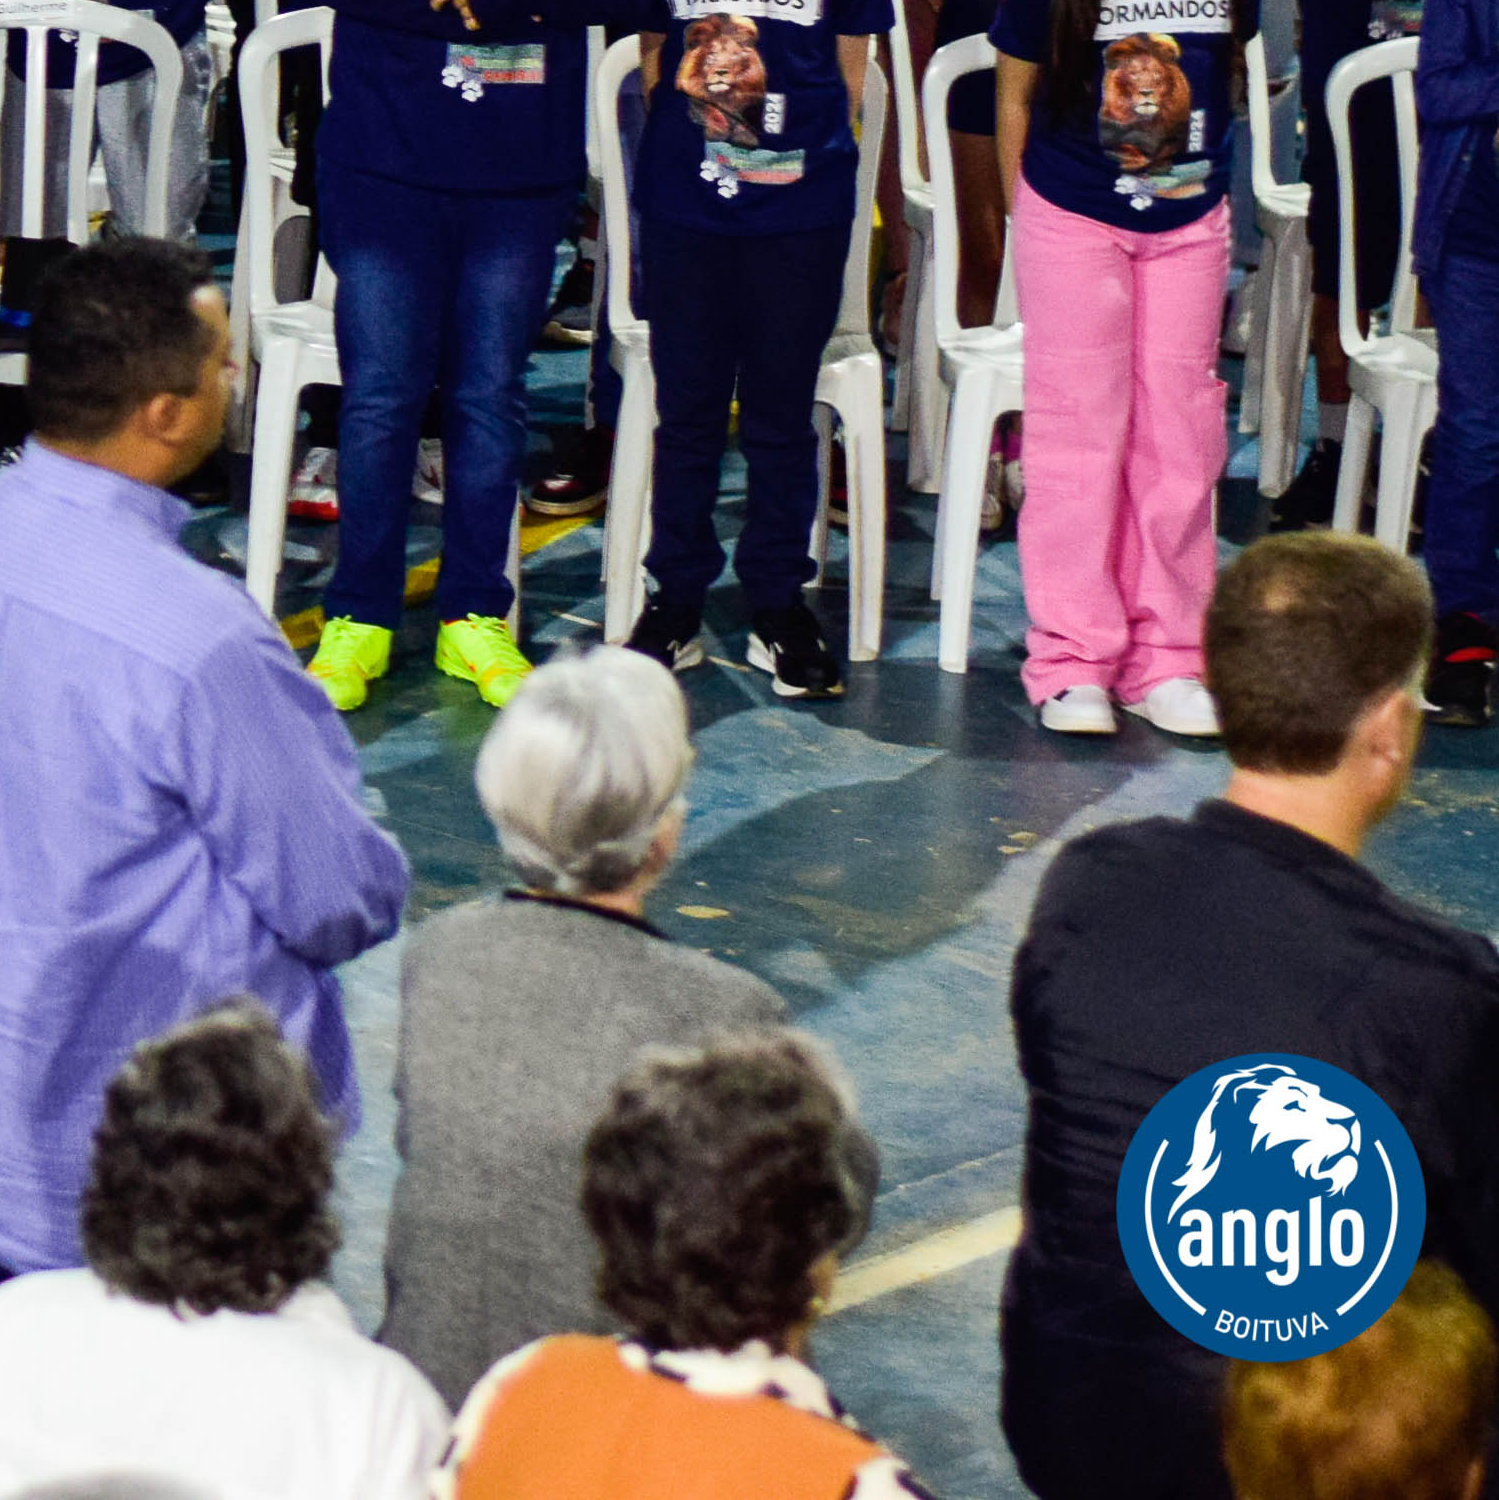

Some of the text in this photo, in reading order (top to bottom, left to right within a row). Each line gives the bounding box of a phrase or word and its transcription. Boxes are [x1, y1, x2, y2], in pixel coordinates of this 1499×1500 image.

[1099, 0, 1229, 27] ORMANDOS
[764, 94, 784, 133] 2024
[1188, 109, 1204, 151] 2024
